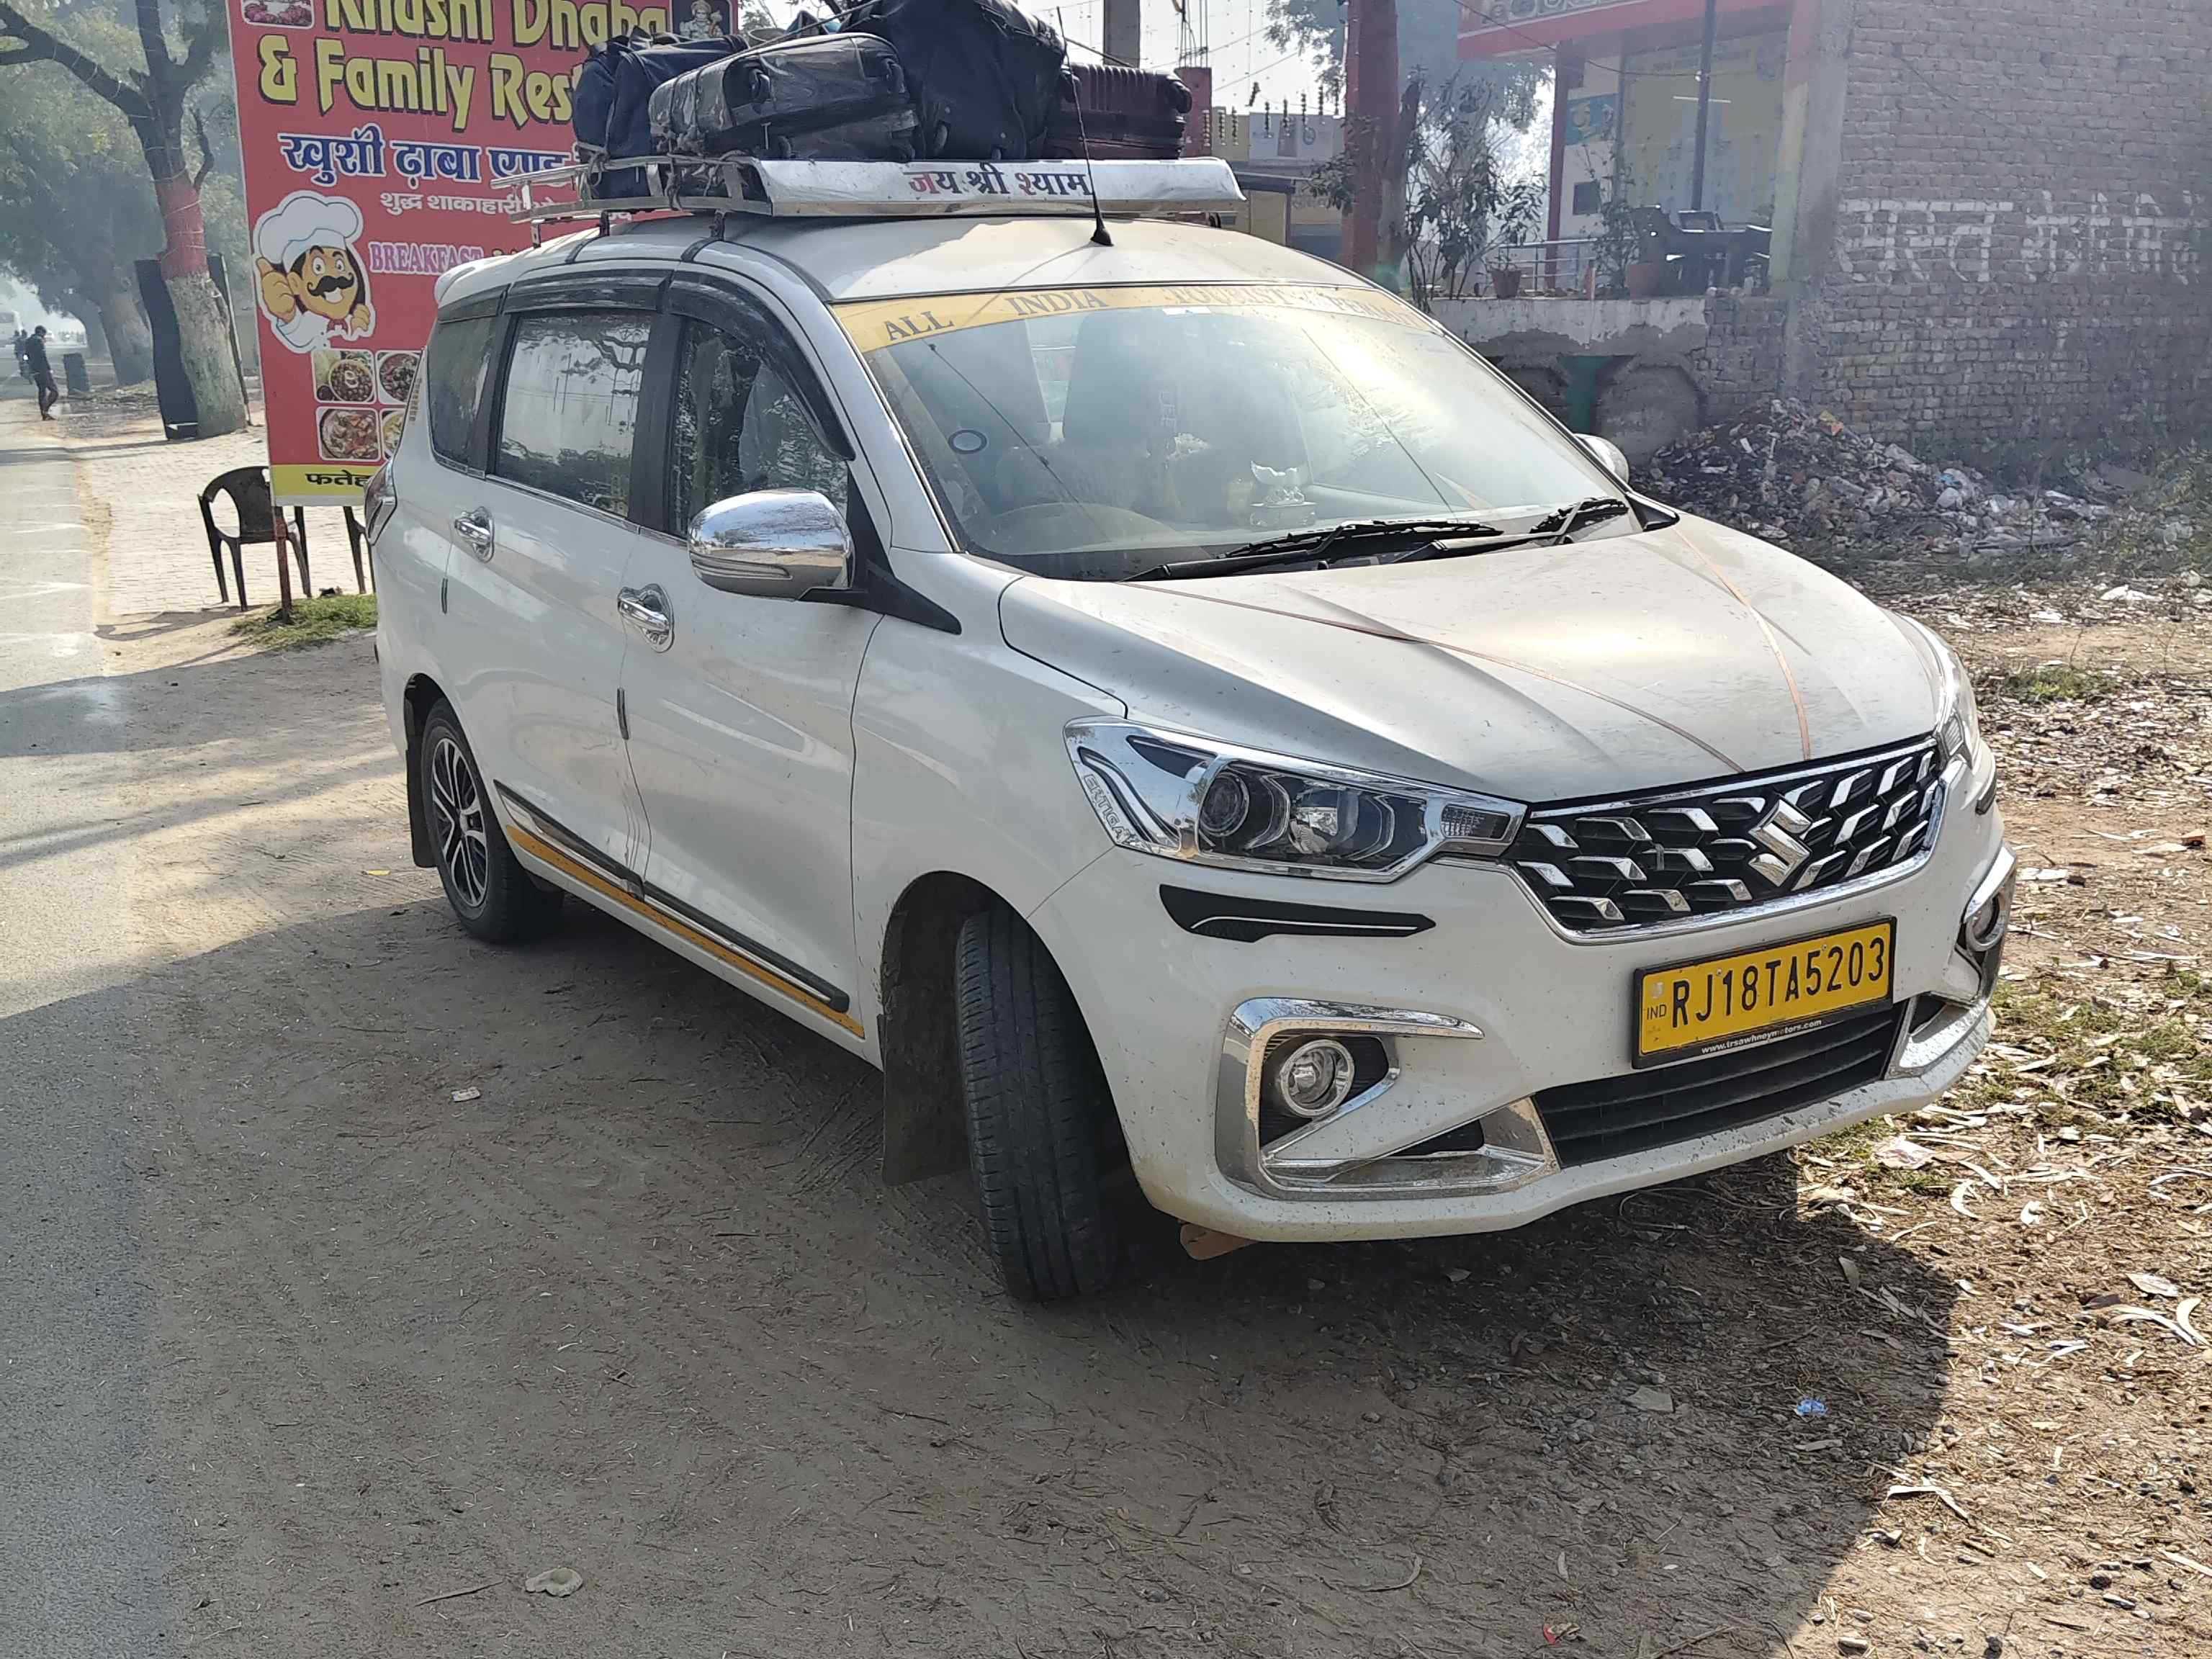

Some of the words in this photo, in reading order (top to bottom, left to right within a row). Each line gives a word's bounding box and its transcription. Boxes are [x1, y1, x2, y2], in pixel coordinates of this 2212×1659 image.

[258, 34, 298, 104] &
[315, 37, 476, 132] Family
[278, 124, 386, 185] खुशी
[903, 171, 962, 194] जय
[966, 161, 1010, 194] श्री
[1014, 171, 1094, 196] श्याम
[884, 310, 954, 341] ALL
[1004, 289, 1109, 316] INDIA
[1672, 937, 1886, 1028] RJ18TA5203
[1646, 1004, 1667, 1020] IND
